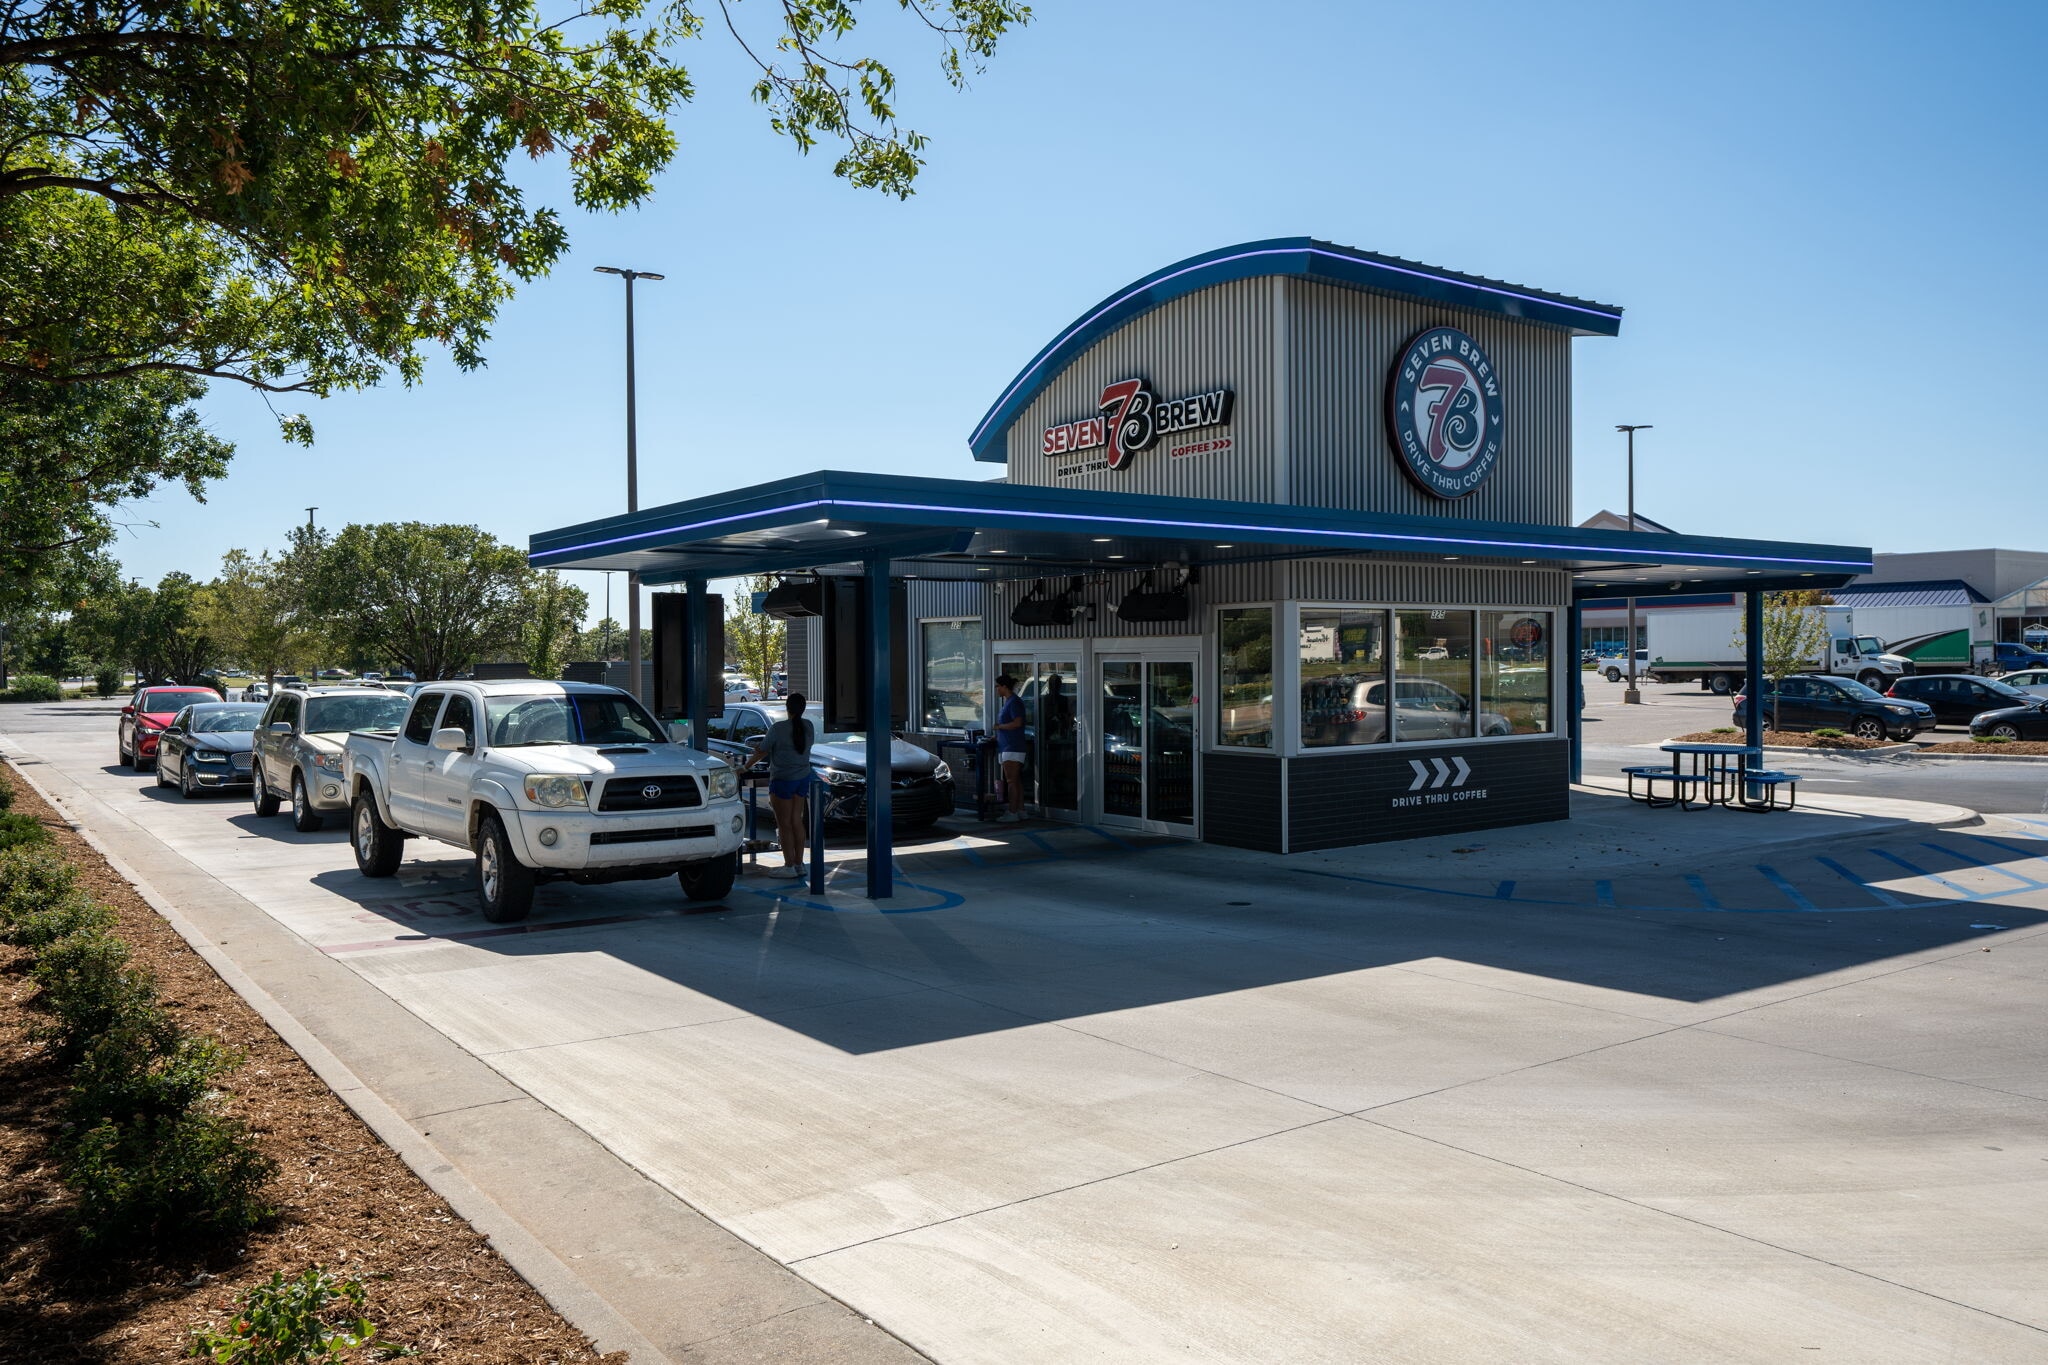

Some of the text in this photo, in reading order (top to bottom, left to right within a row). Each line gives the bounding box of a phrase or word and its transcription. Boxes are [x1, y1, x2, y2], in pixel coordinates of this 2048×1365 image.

[1405, 335, 1498, 397] SEVEN BREW
[1043, 416, 1105, 455] SEVEN
[1156, 390, 1225, 435] BREW
[1058, 442, 1210, 477] DRIVE THRU COFFEE
[1404, 430, 1497, 490] DRIVE THRU COFFEE
[1431, 609, 1446, 620] 325
[1392, 789, 1487, 807] DRIVE THRU COFFEE
